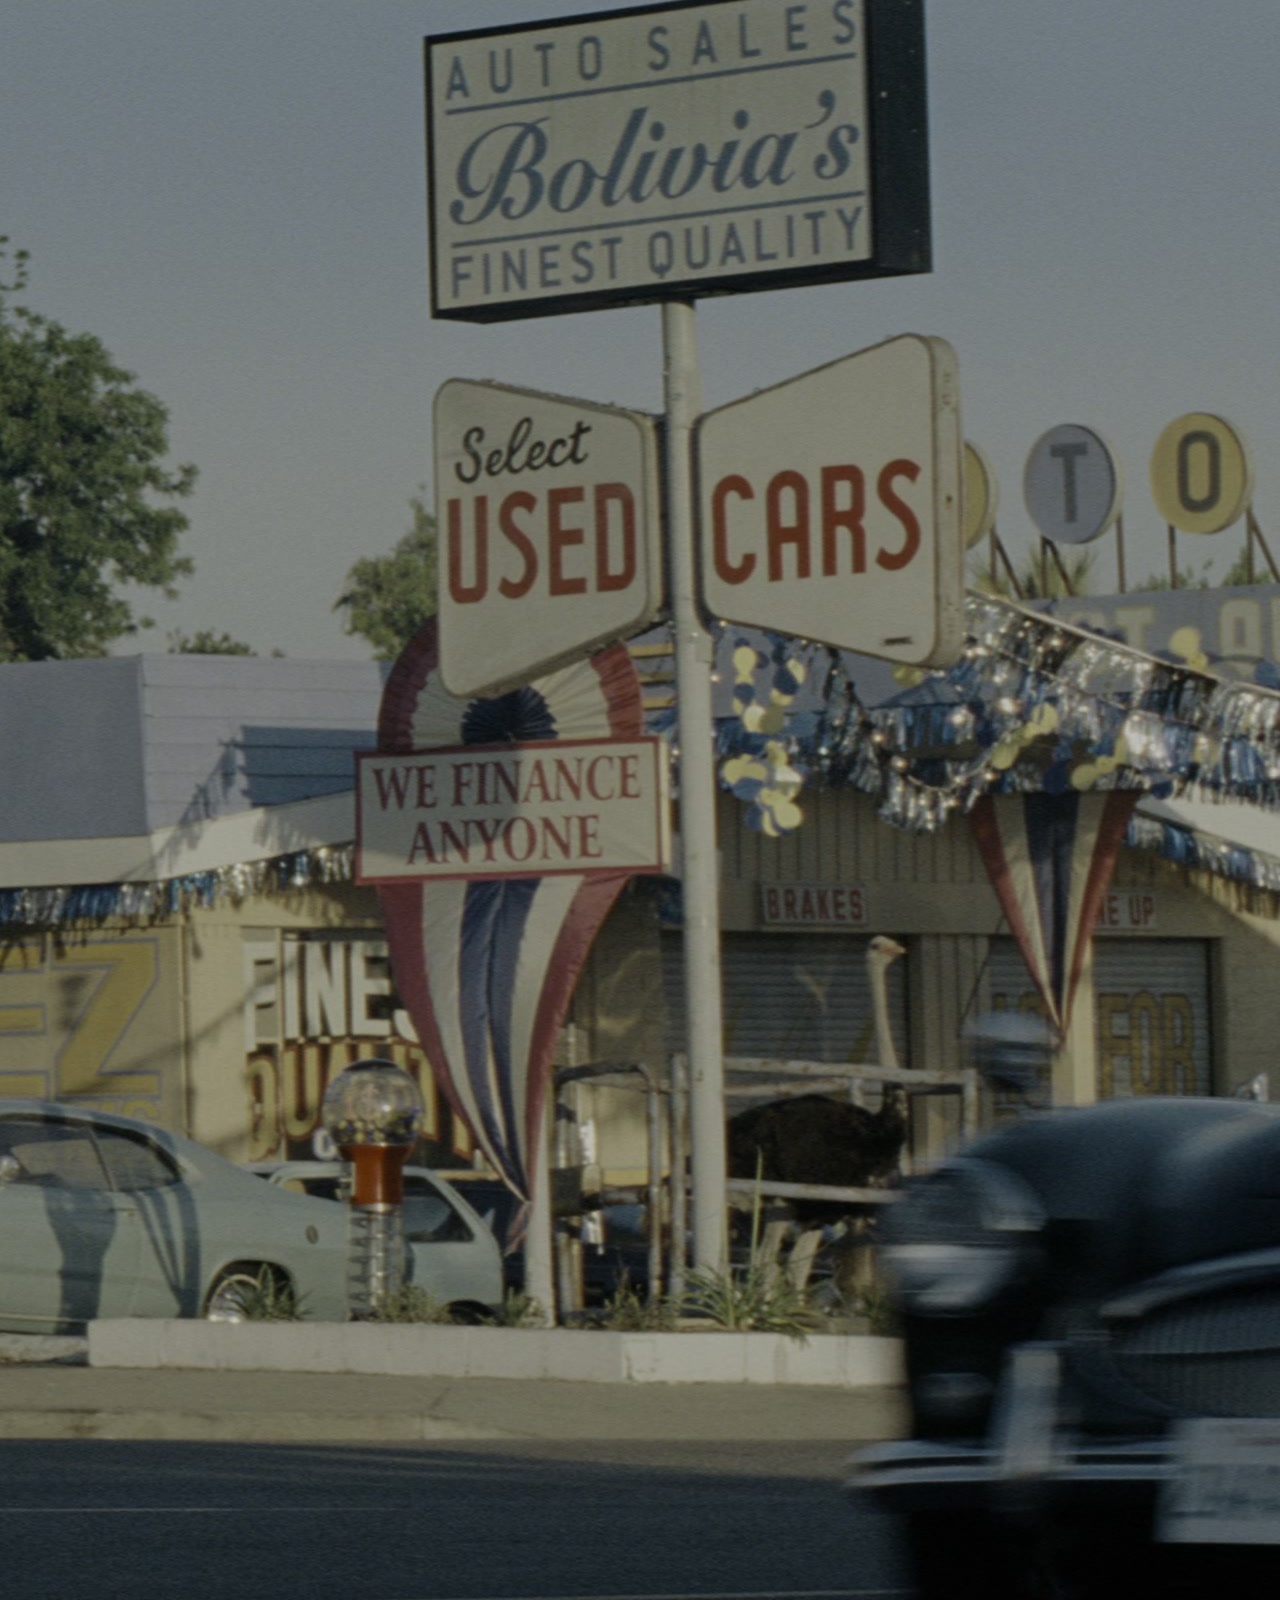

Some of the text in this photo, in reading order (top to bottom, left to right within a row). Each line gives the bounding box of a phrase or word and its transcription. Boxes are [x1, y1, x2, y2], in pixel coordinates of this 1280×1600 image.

[445, 0, 858, 101] AUTO SALES
[449, 89, 860, 226] Bolivia's
[451, 205, 865, 299] FINEST QUALITY
[454, 415, 592, 485] Select
[1050, 430, 1221, 523] TO
[446, 480, 637, 605] USED
[711, 458, 922, 586] CARS
[373, 754, 641, 810] WE FINANCE
[406, 814, 602, 866] ANYONE
[766, 887, 864, 921] BRAKES
[1129, 895, 1155, 926] UP
[243, 939, 421, 1054] FINE
[1099, 989, 1198, 1097] FOR
